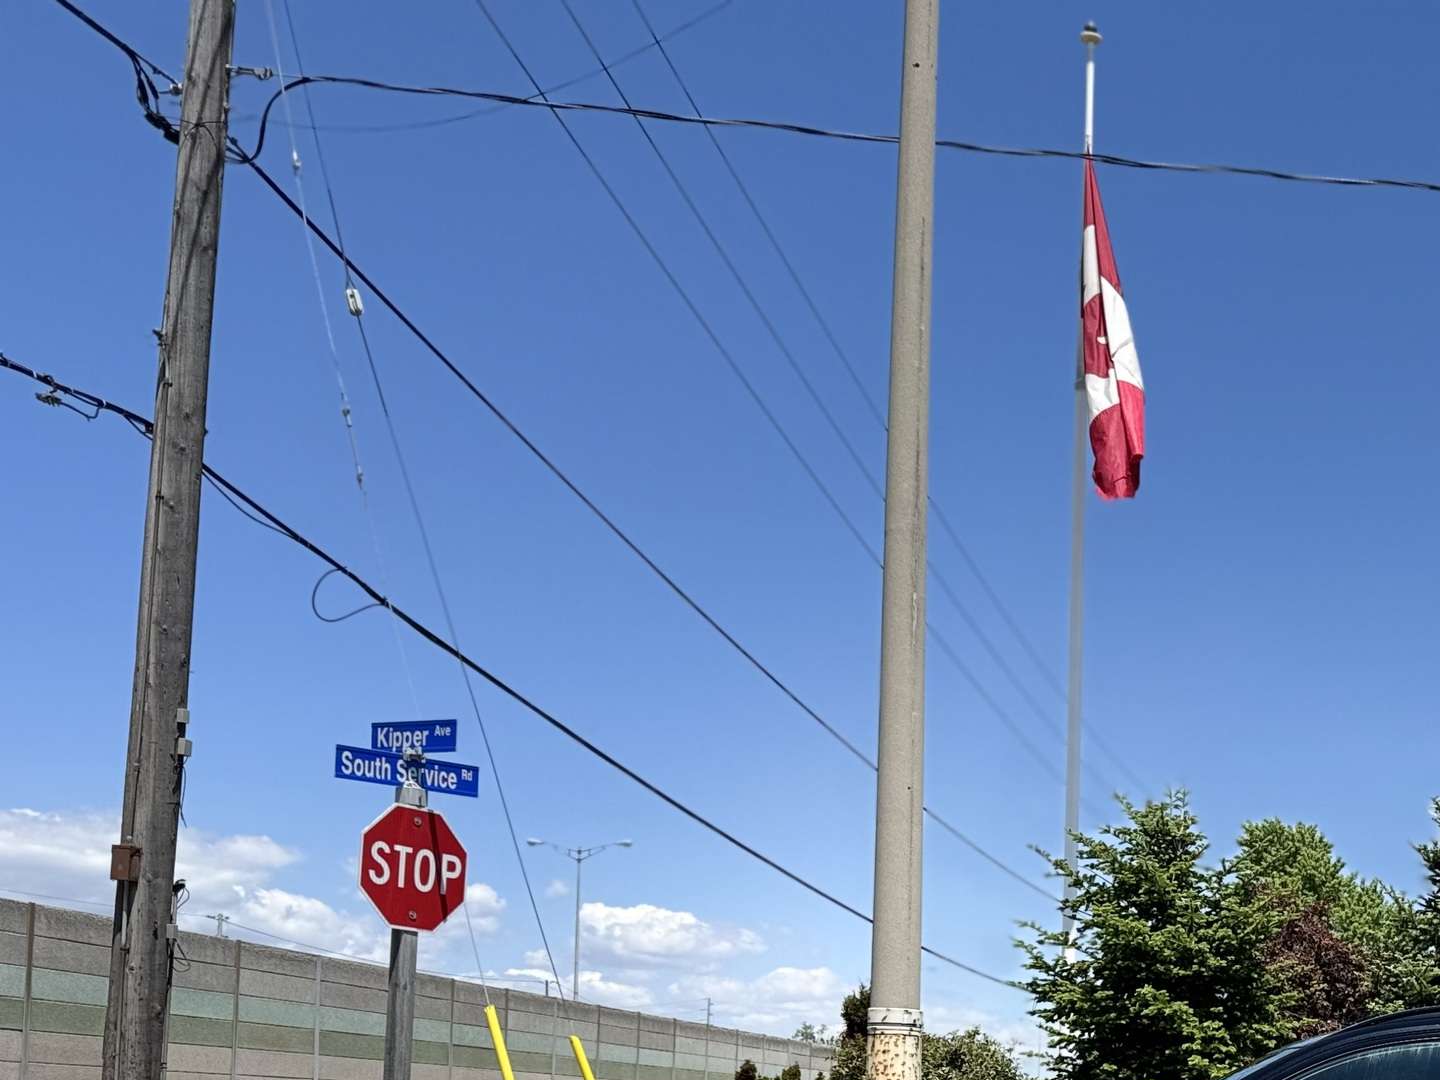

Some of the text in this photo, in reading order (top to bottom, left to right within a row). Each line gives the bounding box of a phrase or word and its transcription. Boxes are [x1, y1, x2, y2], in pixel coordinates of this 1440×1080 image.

[377, 725, 451, 752] Kipper Ave
[341, 751, 473, 789] South Service Rd
[368, 840, 462, 895] STOP
